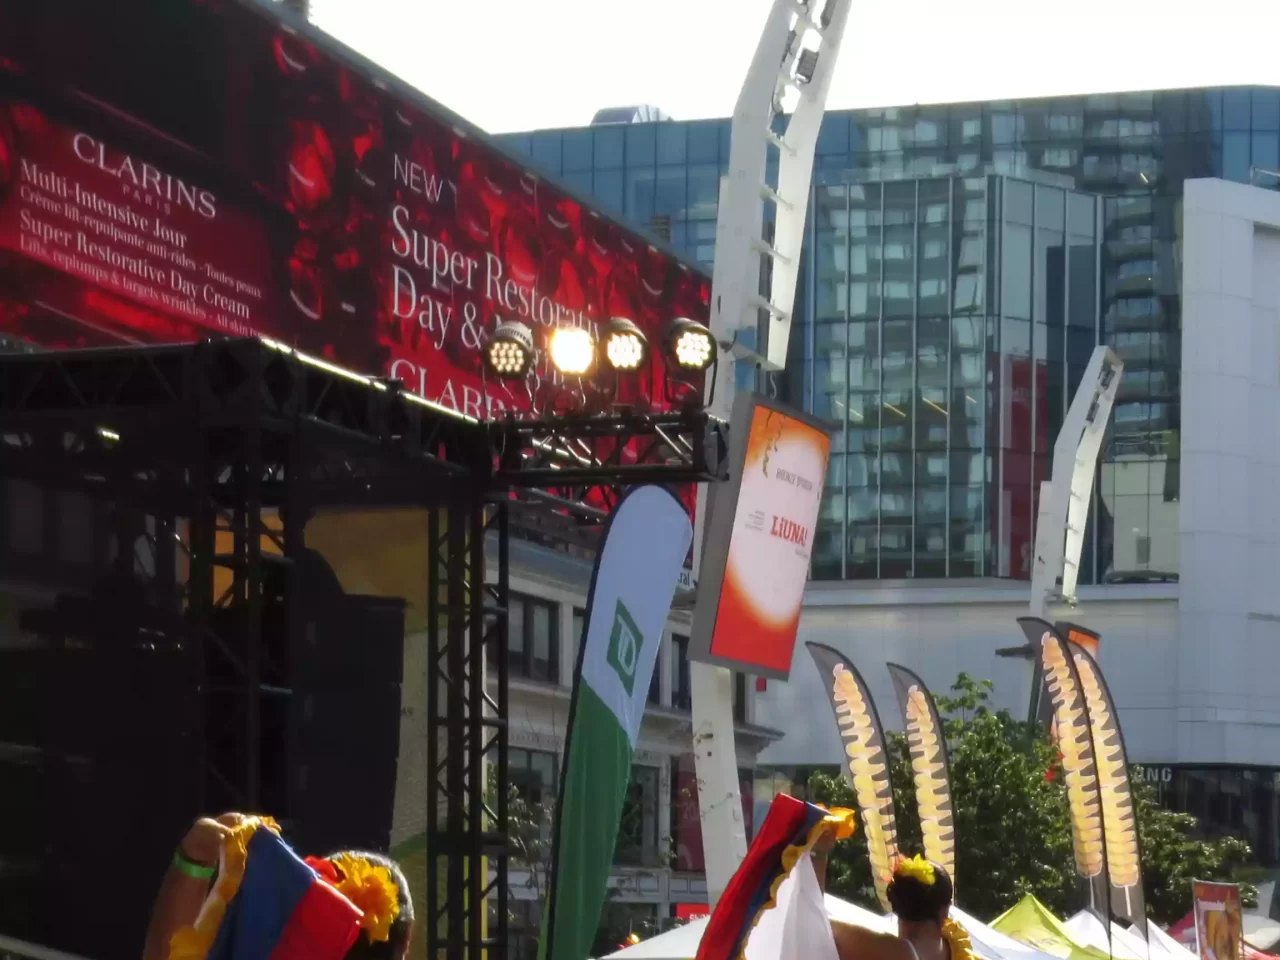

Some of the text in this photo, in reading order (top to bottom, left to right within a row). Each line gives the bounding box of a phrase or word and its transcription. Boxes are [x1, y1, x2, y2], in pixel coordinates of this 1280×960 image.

[20, 158, 188, 249] Multi-Intensive Jour
[73, 132, 216, 219] CLARINS
[393, 153, 443, 203] NEW
[20, 208, 249, 320] Super Restorative Day Cream
[52, 250, 109, 282] replumps
[110, 270, 120, 286] &
[122, 275, 158, 299] targets
[161, 292, 207, 320] wrinkles
[216, 312, 229, 329] All
[391, 205, 478, 290] Super
[393, 264, 482, 350] Day &
